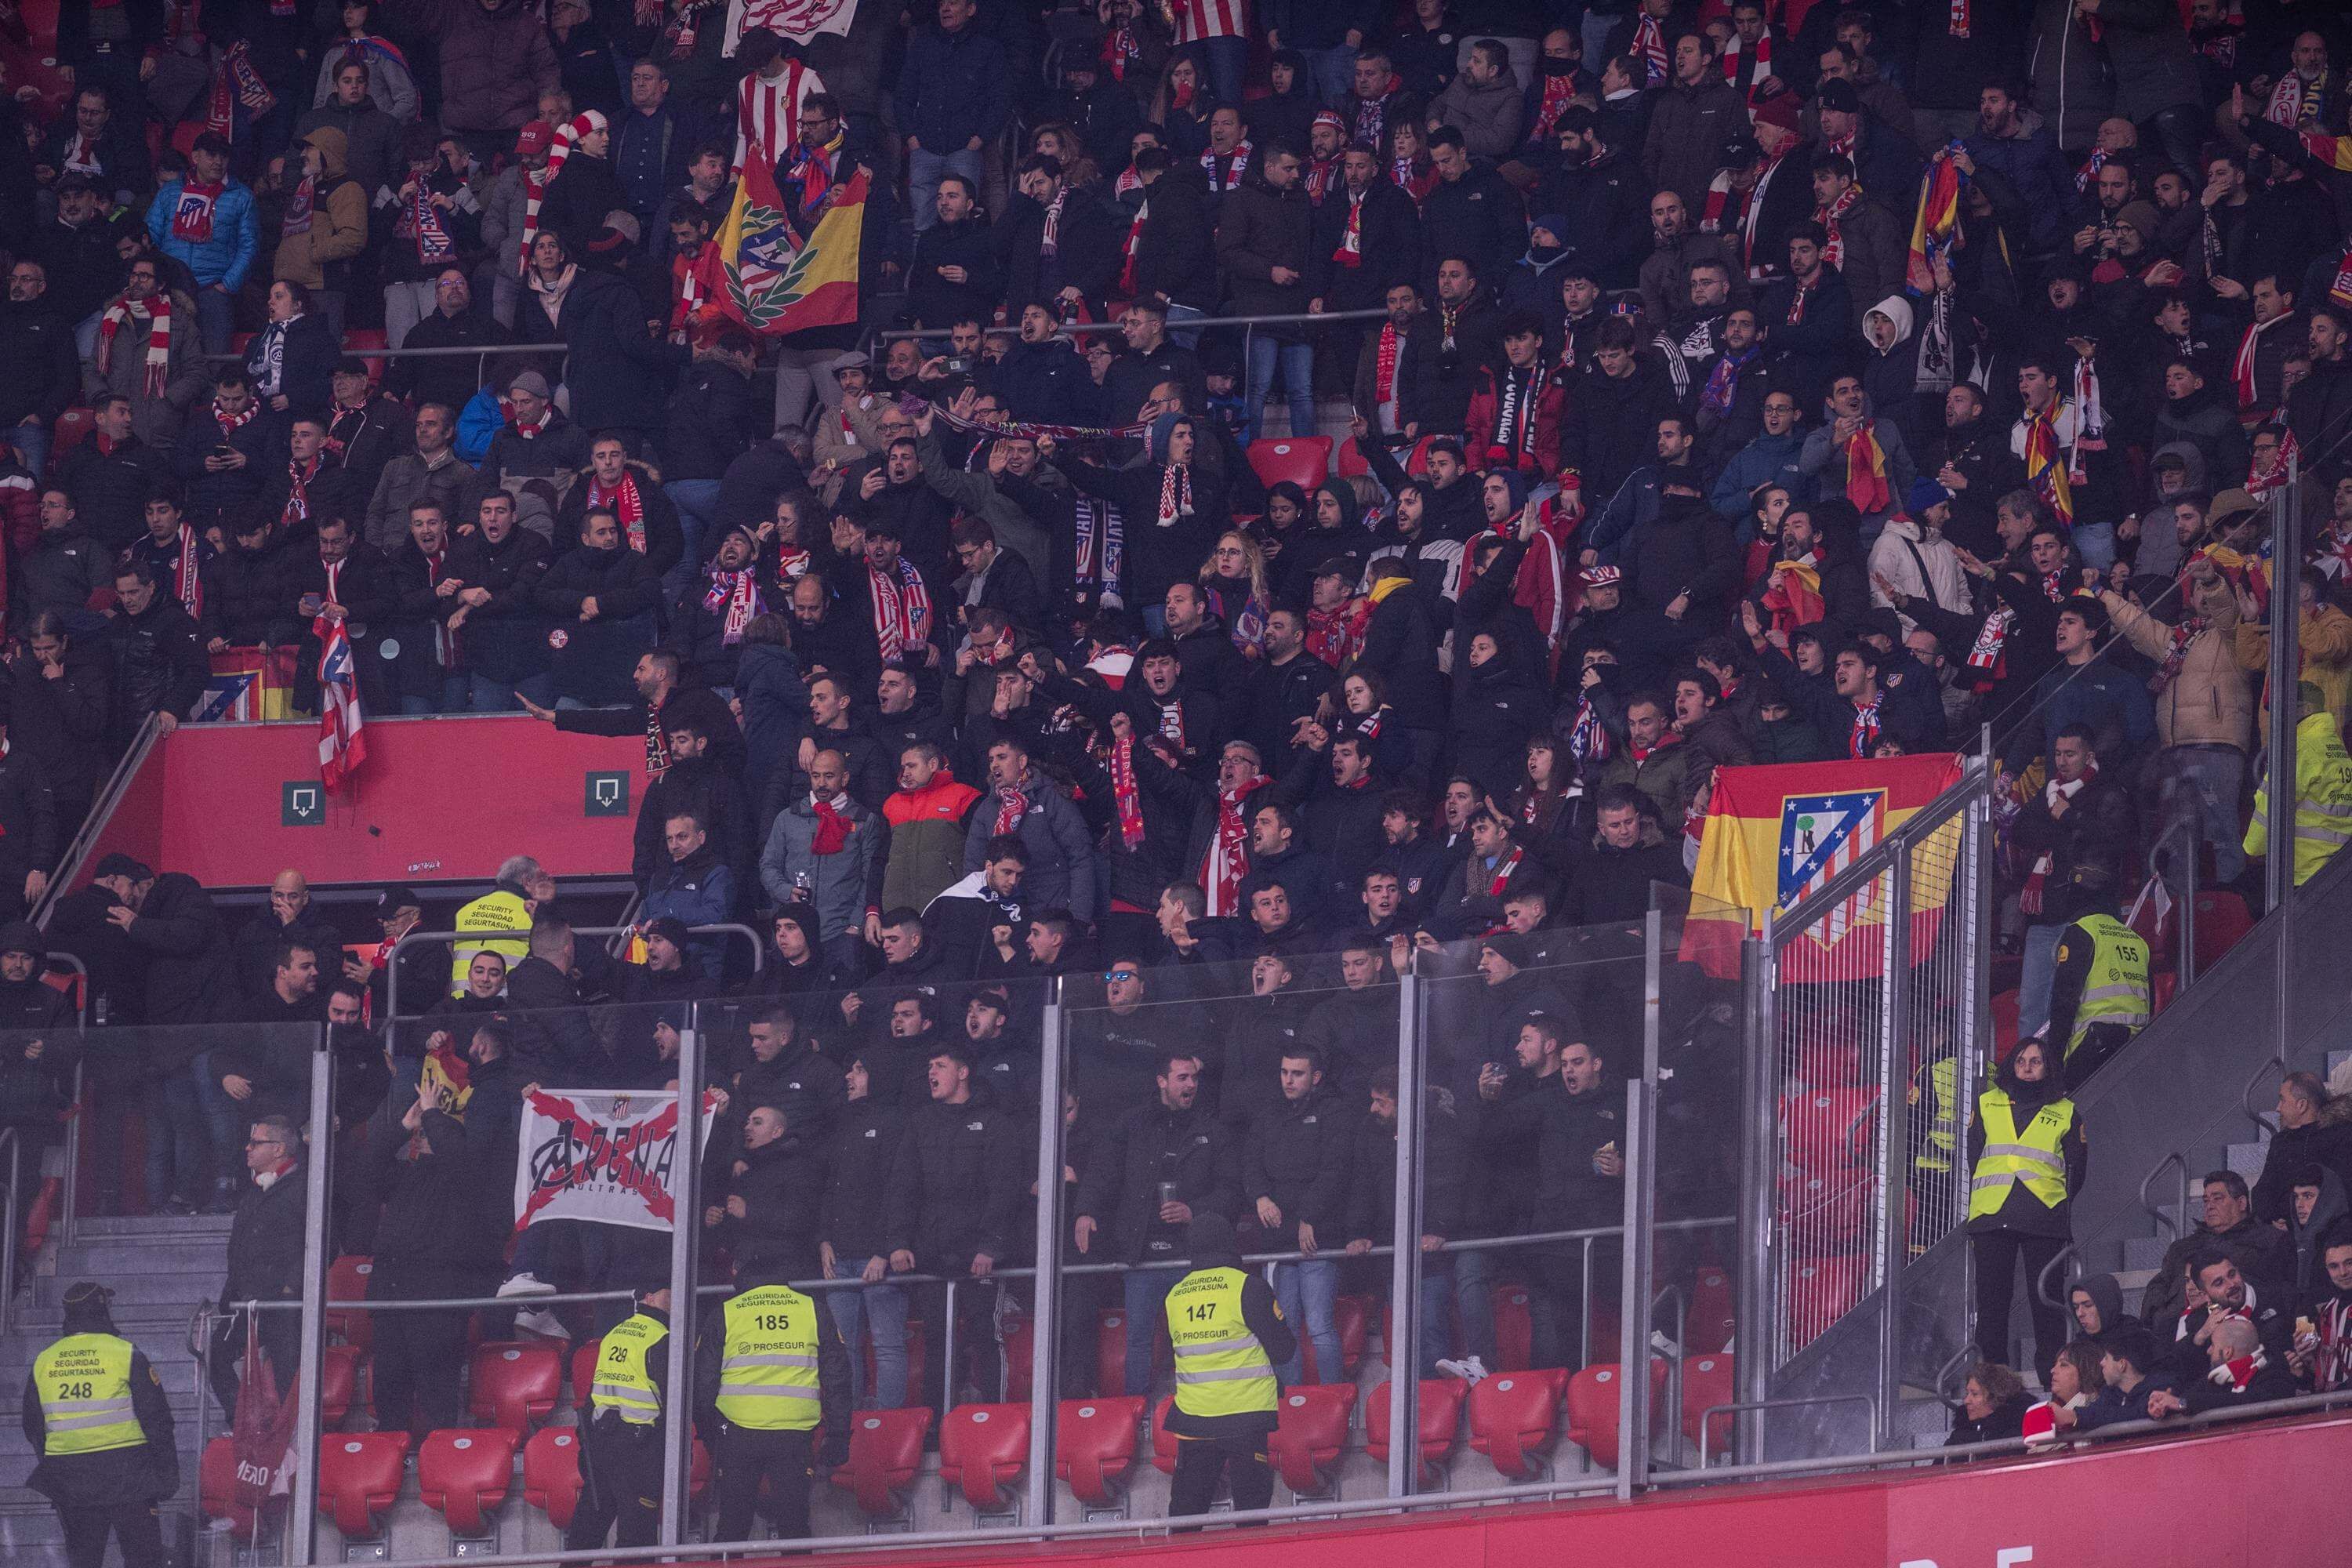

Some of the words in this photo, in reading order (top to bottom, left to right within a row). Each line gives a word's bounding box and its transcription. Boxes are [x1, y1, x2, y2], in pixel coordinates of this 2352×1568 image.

[477, 904, 514, 915] SECURITY
[471, 911, 514, 923] SEGURIDAD
[2116, 945, 2139, 962] 155
[2040, 1116, 2058, 1127] 171
[578, 1184, 638, 1196] ULTRAS
[1181, 1276, 1224, 1287] SEGURIDAD
[1174, 1283, 1229, 1296] SEGURTASUNA
[741, 1293, 792, 1301] SEGURIDAD
[735, 1299, 800, 1309] SEGURTASUNA
[1186, 1303, 1216, 1322] 147
[755, 1315, 789, 1330] 185
[1183, 1330, 1229, 1340] PROSEGUR
[753, 1341, 804, 1351] PROSEGUR
[59, 1349, 97, 1358] SECURITY
[55, 1359, 100, 1367] SEGURIDAD
[49, 1367, 106, 1377] SEGURTASUNA
[59, 1382, 93, 1399] 248
